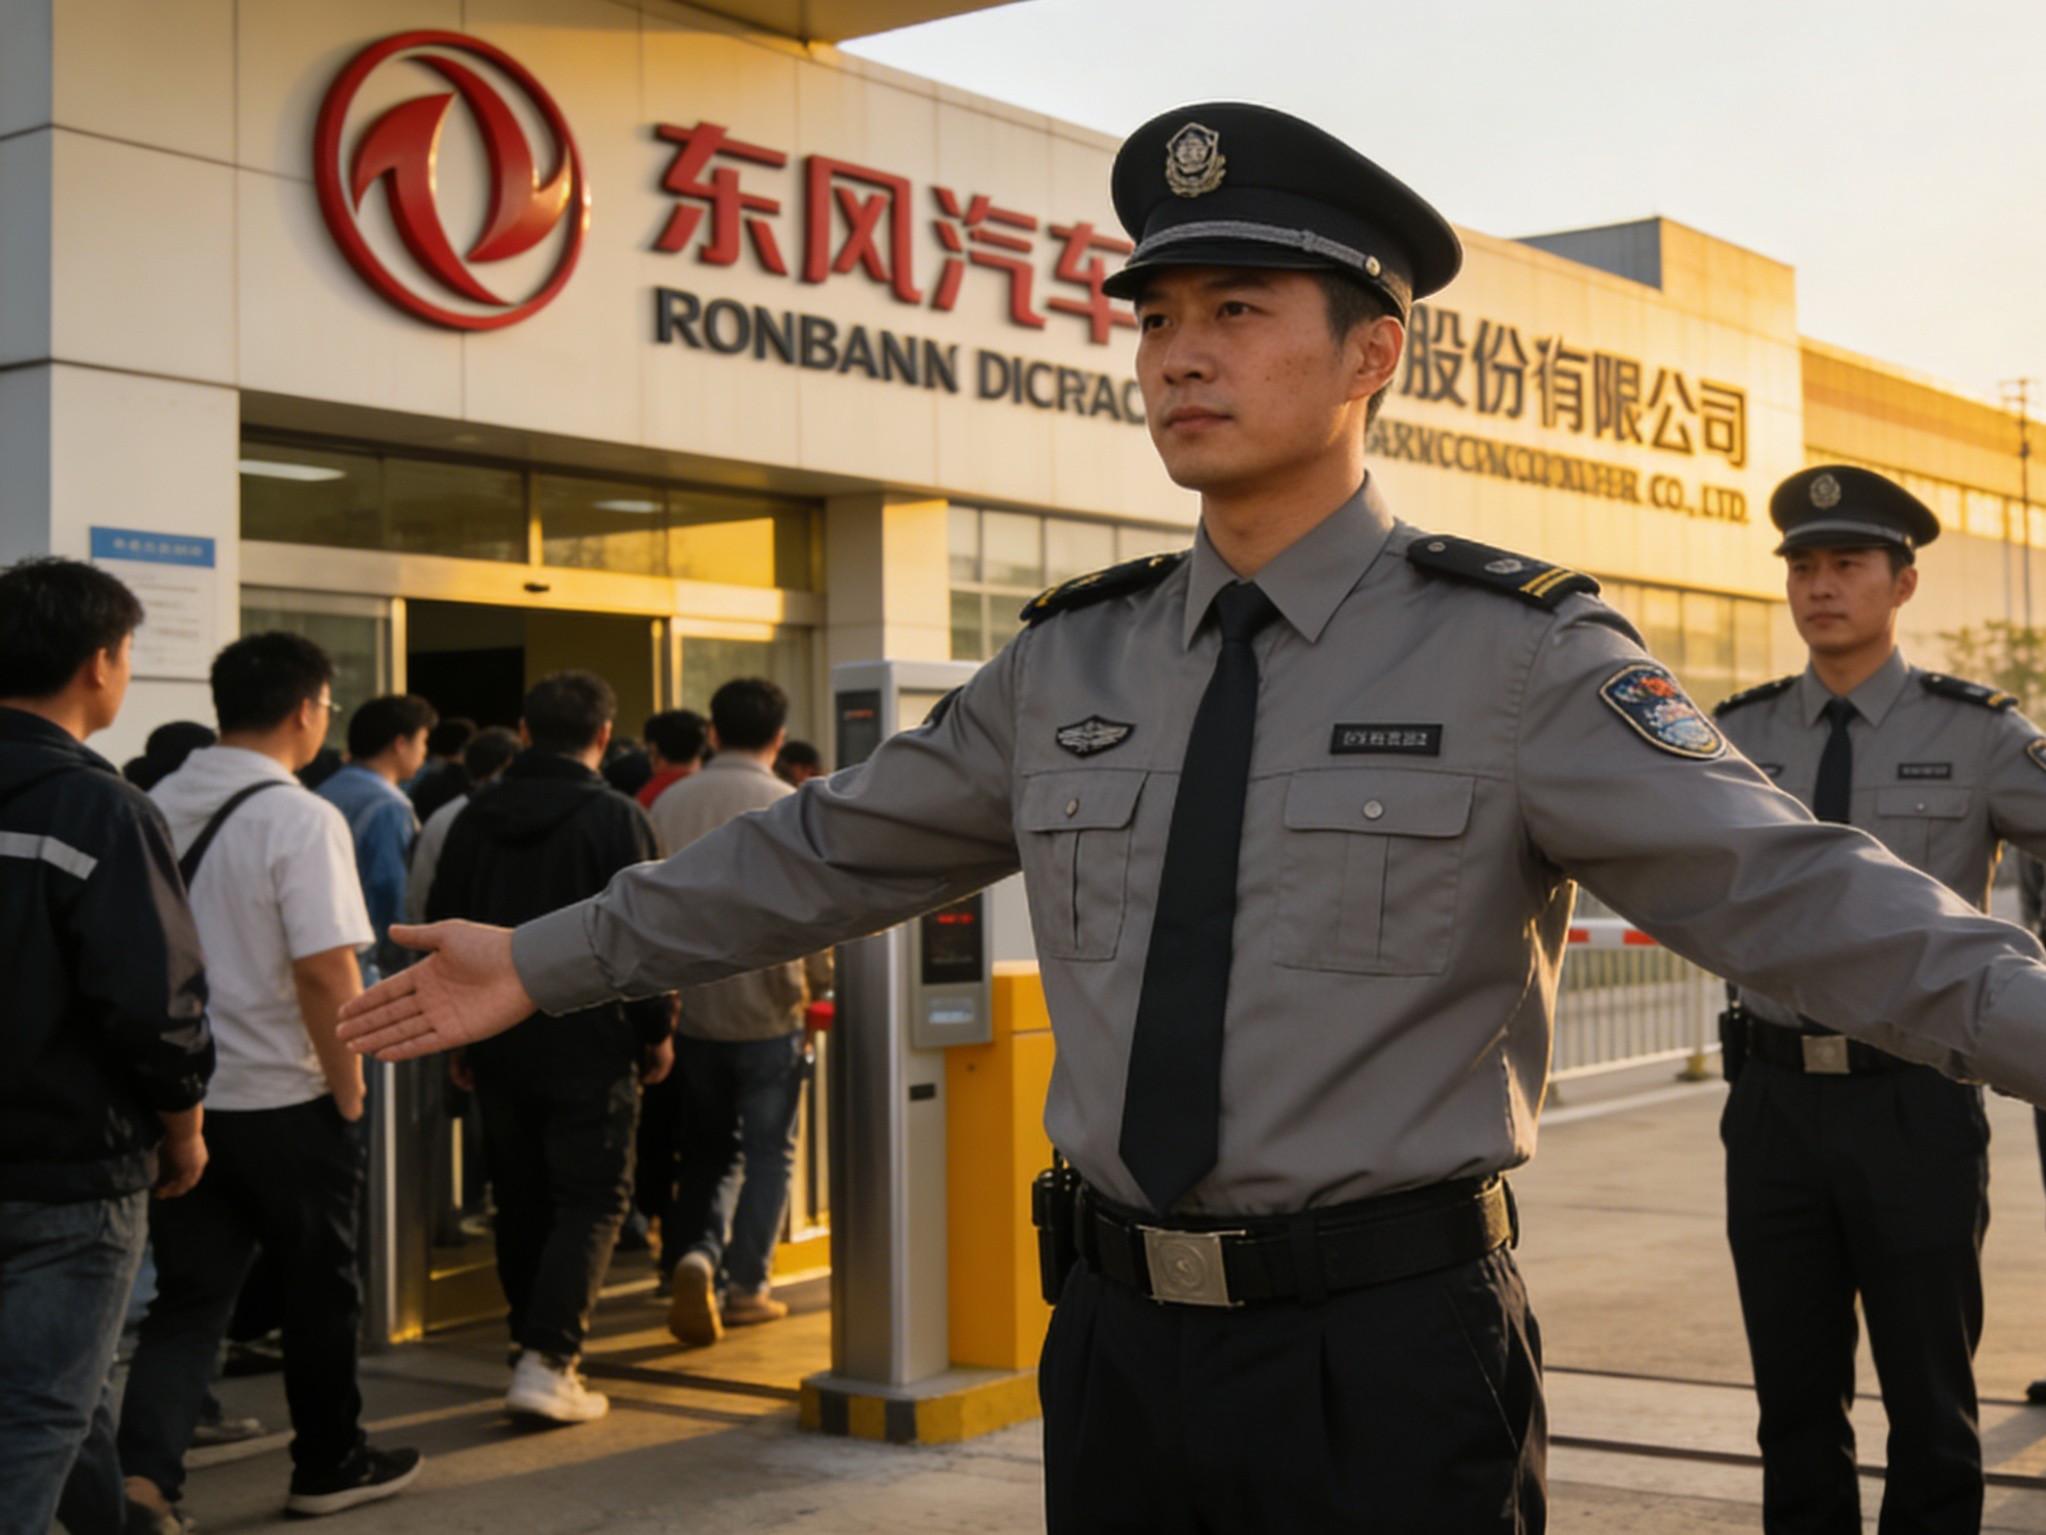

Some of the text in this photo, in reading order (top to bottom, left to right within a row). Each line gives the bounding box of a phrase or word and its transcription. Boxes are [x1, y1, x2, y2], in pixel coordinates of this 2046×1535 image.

[654, 120, 1138, 345] 东风汽车
[1402, 304, 1747, 468] 股份有限公司
[655, 287, 960, 393] RONBANN
